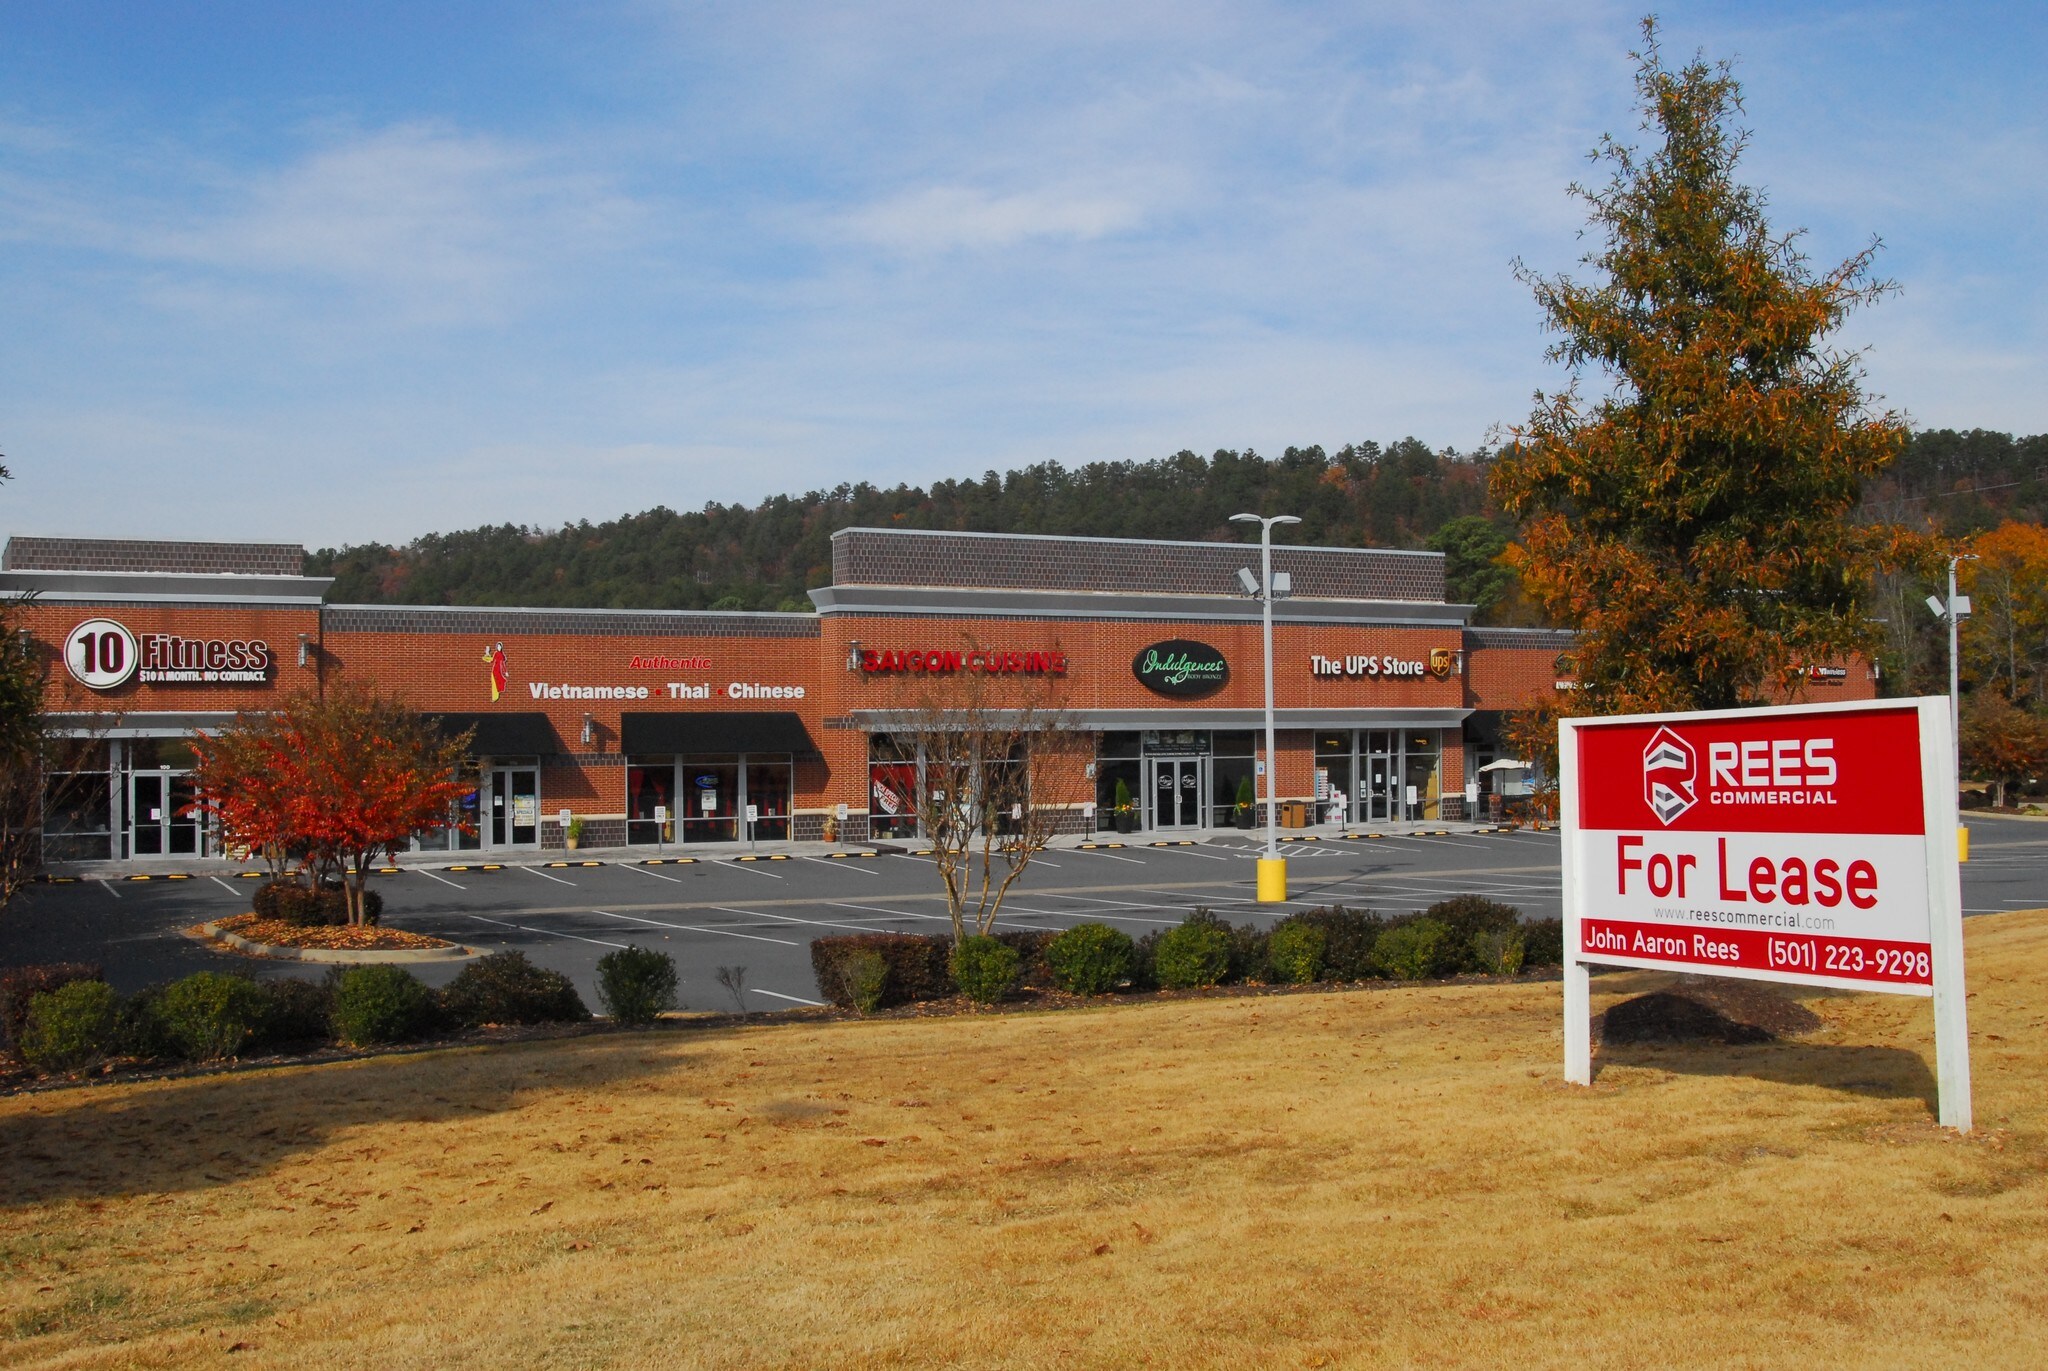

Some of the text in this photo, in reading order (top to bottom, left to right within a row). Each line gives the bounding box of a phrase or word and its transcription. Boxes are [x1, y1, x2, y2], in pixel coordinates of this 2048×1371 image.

[78, 632, 124, 674] 10
[140, 634, 268, 670] Fitness
[629, 655, 711, 670] Authentic
[863, 650, 1067, 673] SAIGON CUISINE
[1432, 656, 1448, 671] ups
[140, 671, 266, 682] $10 A MONTH. NO CONTRACT.
[1142, 649, 1224, 683] Indulgences
[1311, 655, 1424, 675] The UPS Store
[529, 683, 805, 699] Vietnamese Thai Chinese
[1709, 738, 1837, 787] REES
[1710, 790, 1838, 805] COMMERCIAL
[1617, 835, 1878, 910] For Lease
[1653, 906, 1836, 930] www.reescommercial.com
[1585, 926, 1930, 978] John Aaron Rees (501) 223-9298
